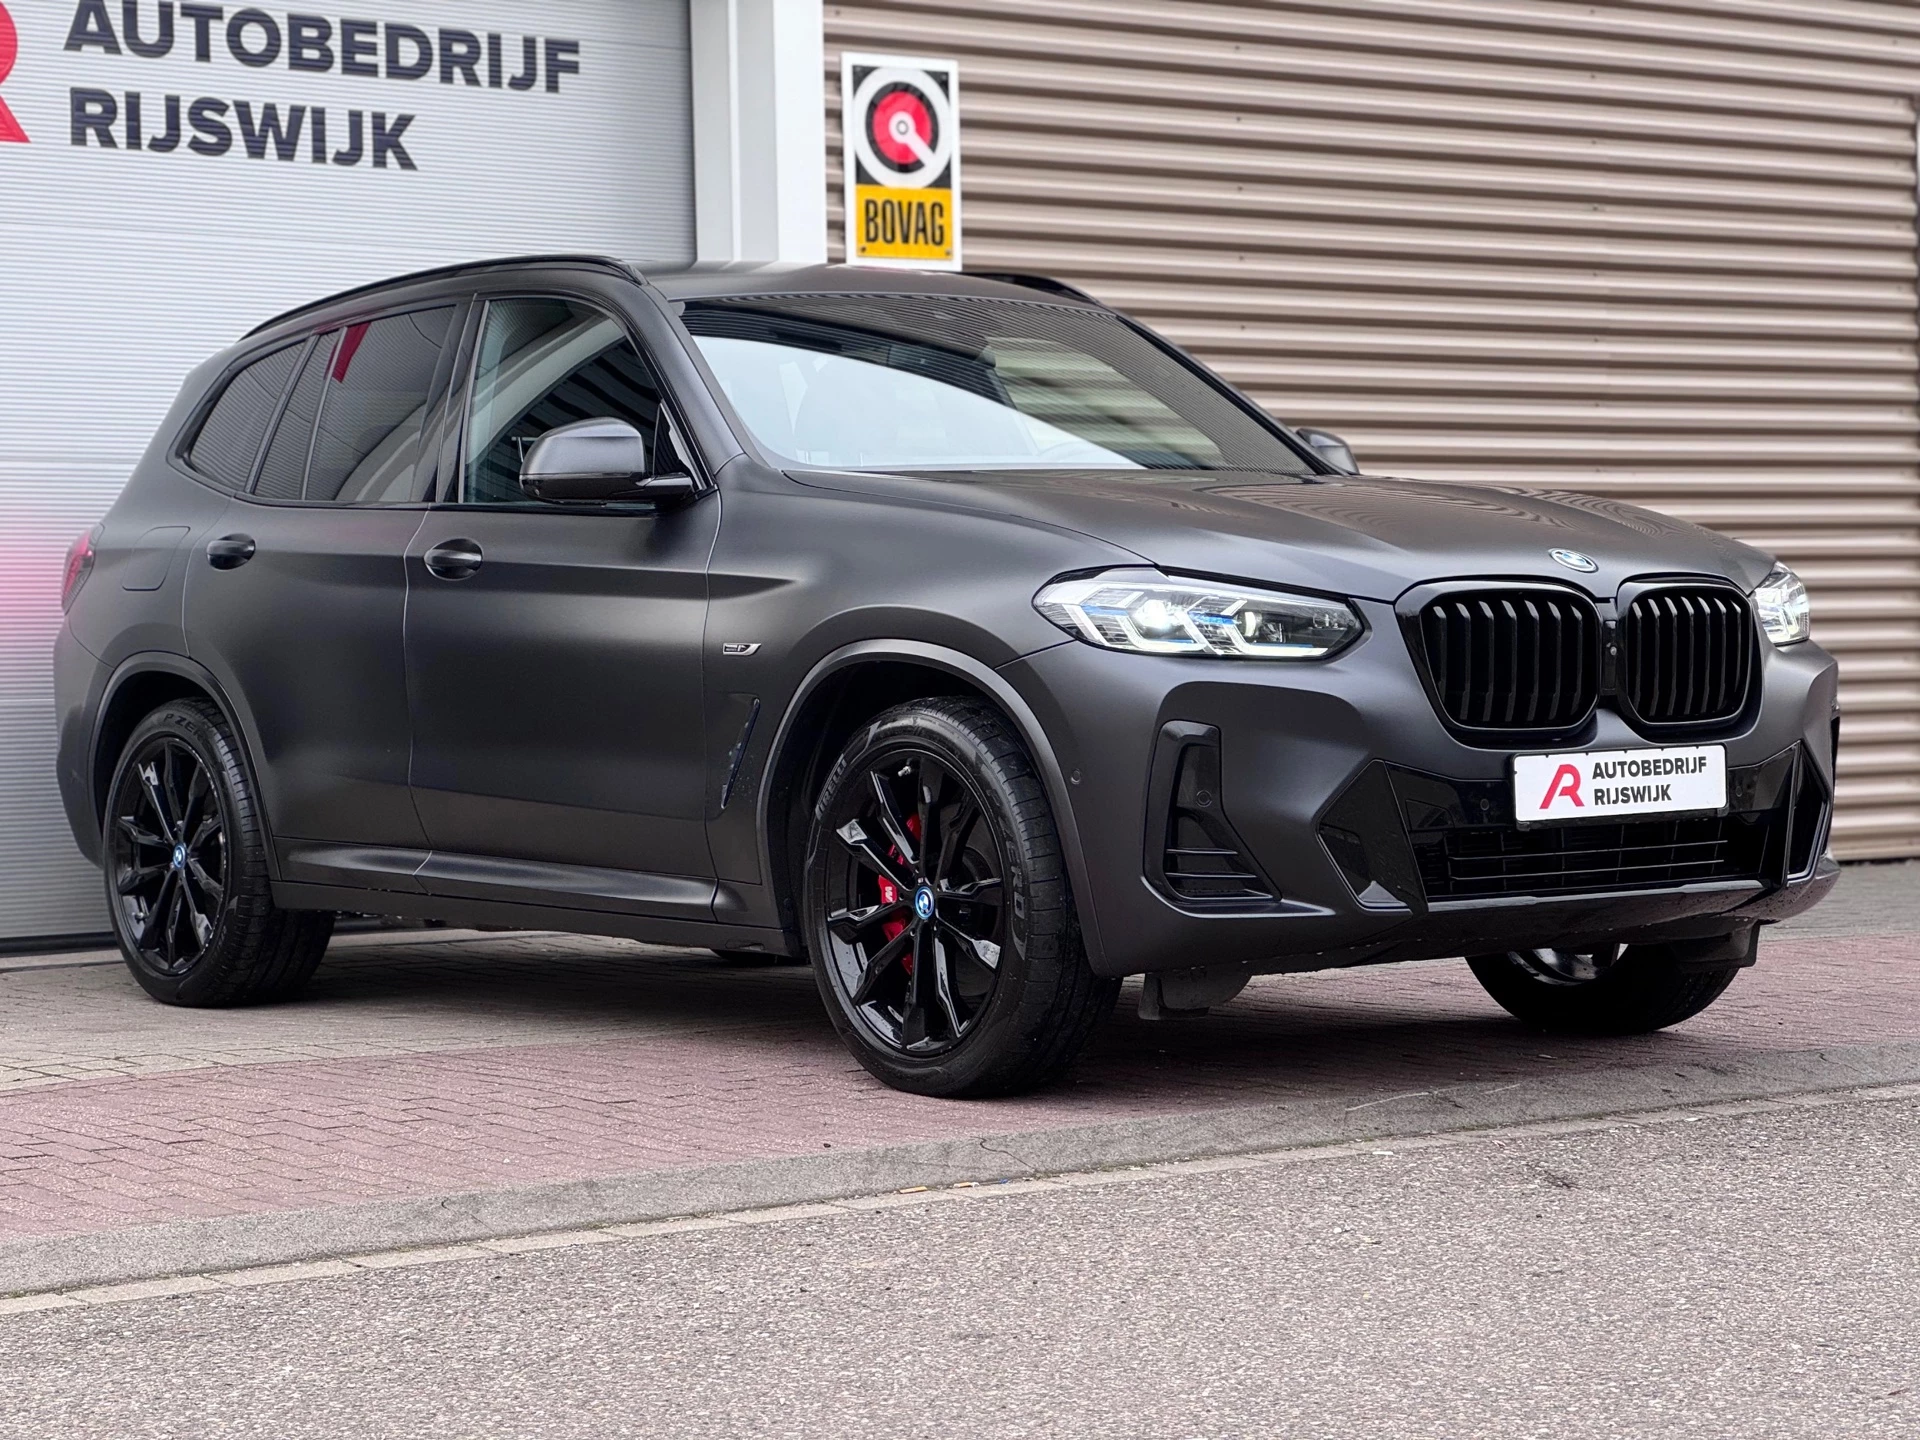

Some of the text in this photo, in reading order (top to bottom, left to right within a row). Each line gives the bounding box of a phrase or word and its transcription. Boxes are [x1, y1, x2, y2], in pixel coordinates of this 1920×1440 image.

[64, 0, 580, 94] AUTOBEDRIJF
[70, 87, 418, 171] RIJSWIJK
[865, 199, 944, 246] BOVAG
[815, 753, 847, 821] PIRELLI
[1592, 756, 1707, 779] AUTOBEDRIJF
[1594, 784, 1672, 806] RIJSWIJK
